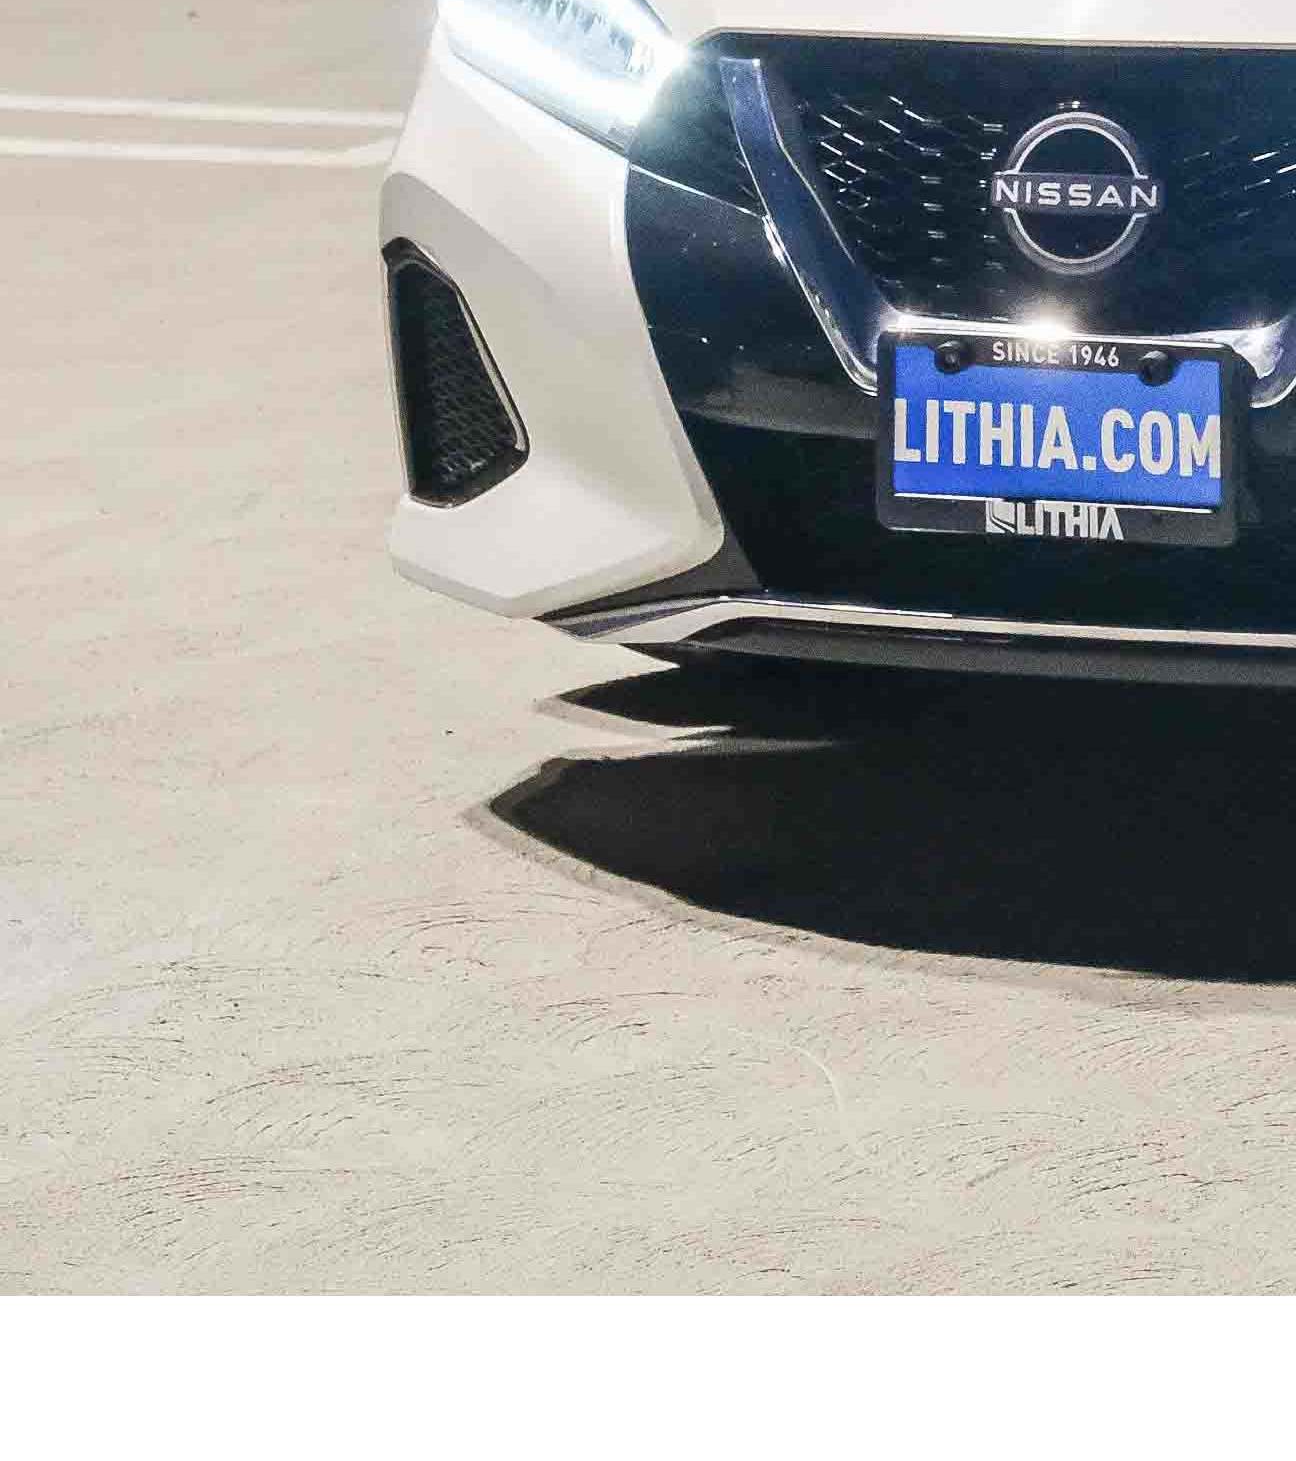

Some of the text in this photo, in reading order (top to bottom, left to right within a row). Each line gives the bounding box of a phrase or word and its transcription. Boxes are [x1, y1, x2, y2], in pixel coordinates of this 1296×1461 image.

[994, 178, 1158, 208] NISSAN
[992, 339, 1120, 368] SINCE 1946
[893, 397, 1221, 479] LITHIA.COM
[1016, 500, 1125, 541] LITHIA
